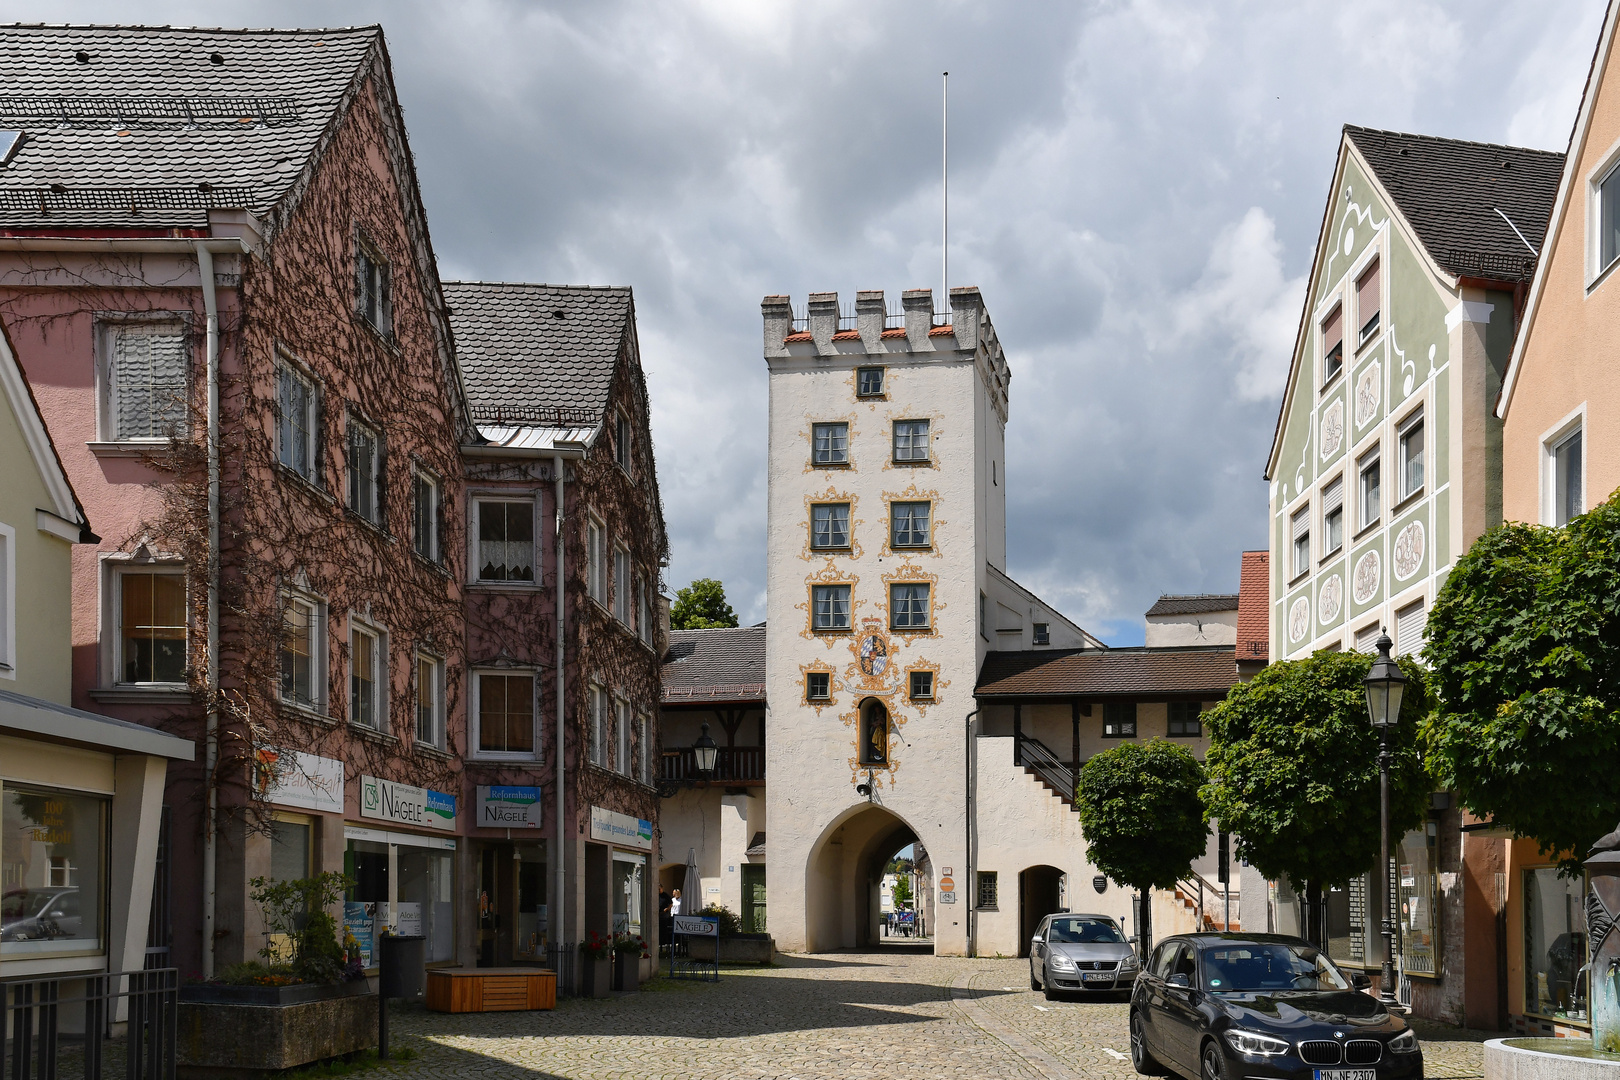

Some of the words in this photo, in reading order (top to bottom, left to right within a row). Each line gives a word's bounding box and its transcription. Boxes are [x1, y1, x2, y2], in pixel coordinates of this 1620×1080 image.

[491, 790, 536, 801] Reformhaus
[44, 801, 63, 814] 100
[382, 783, 422, 823] NÄGELE
[427, 796, 454, 813] Reformhaus
[42, 815, 64, 826] Jahre
[485, 806, 527, 822] NÄGELE
[32, 828, 72, 844] Rudolf
[400, 911, 413, 919] Aloe
[1320, 1070, 1333, 1080] MN
